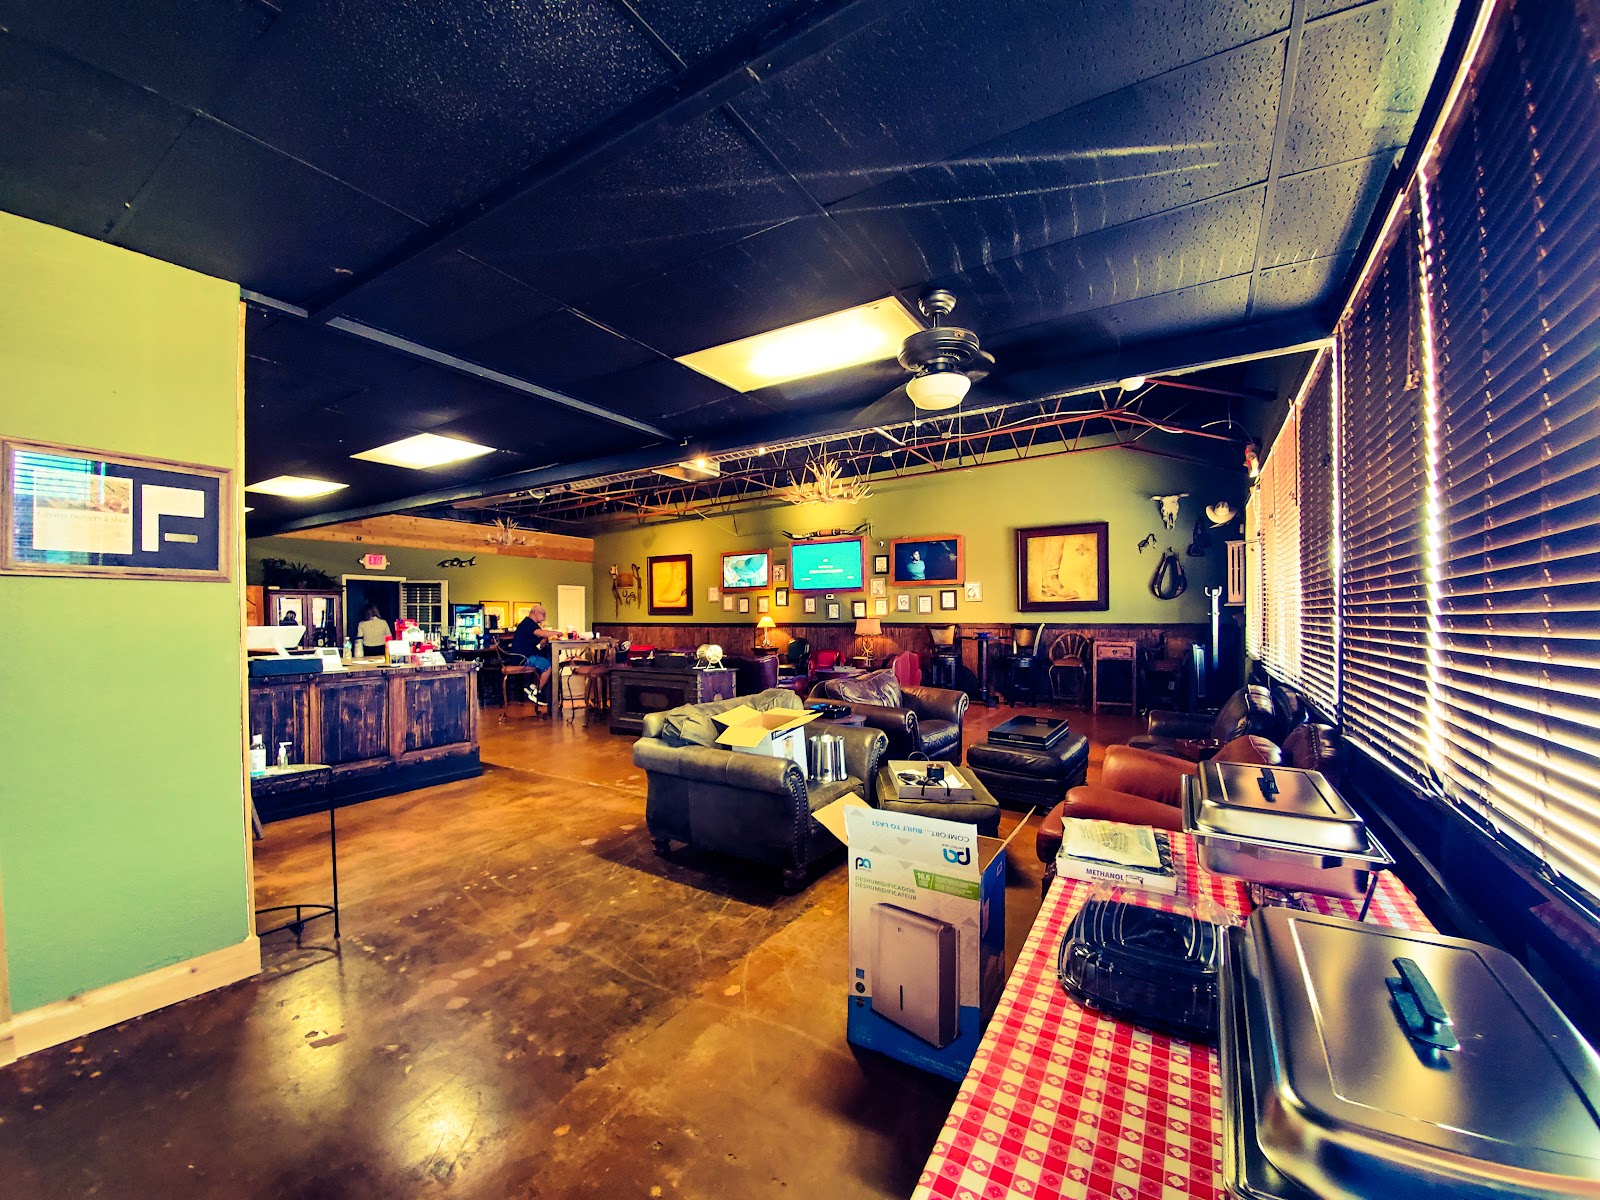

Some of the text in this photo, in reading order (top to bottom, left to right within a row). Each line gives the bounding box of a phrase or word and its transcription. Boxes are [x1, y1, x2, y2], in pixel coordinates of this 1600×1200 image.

[368, 555, 383, 566] EXIT
[871, 820, 889, 829] LAST
[903, 825, 923, 834] BUILT
[855, 856, 872, 870] pa
[1085, 868, 1124, 881] METHANOL
[855, 875, 915, 894] DESHUMIDIFICADOR
